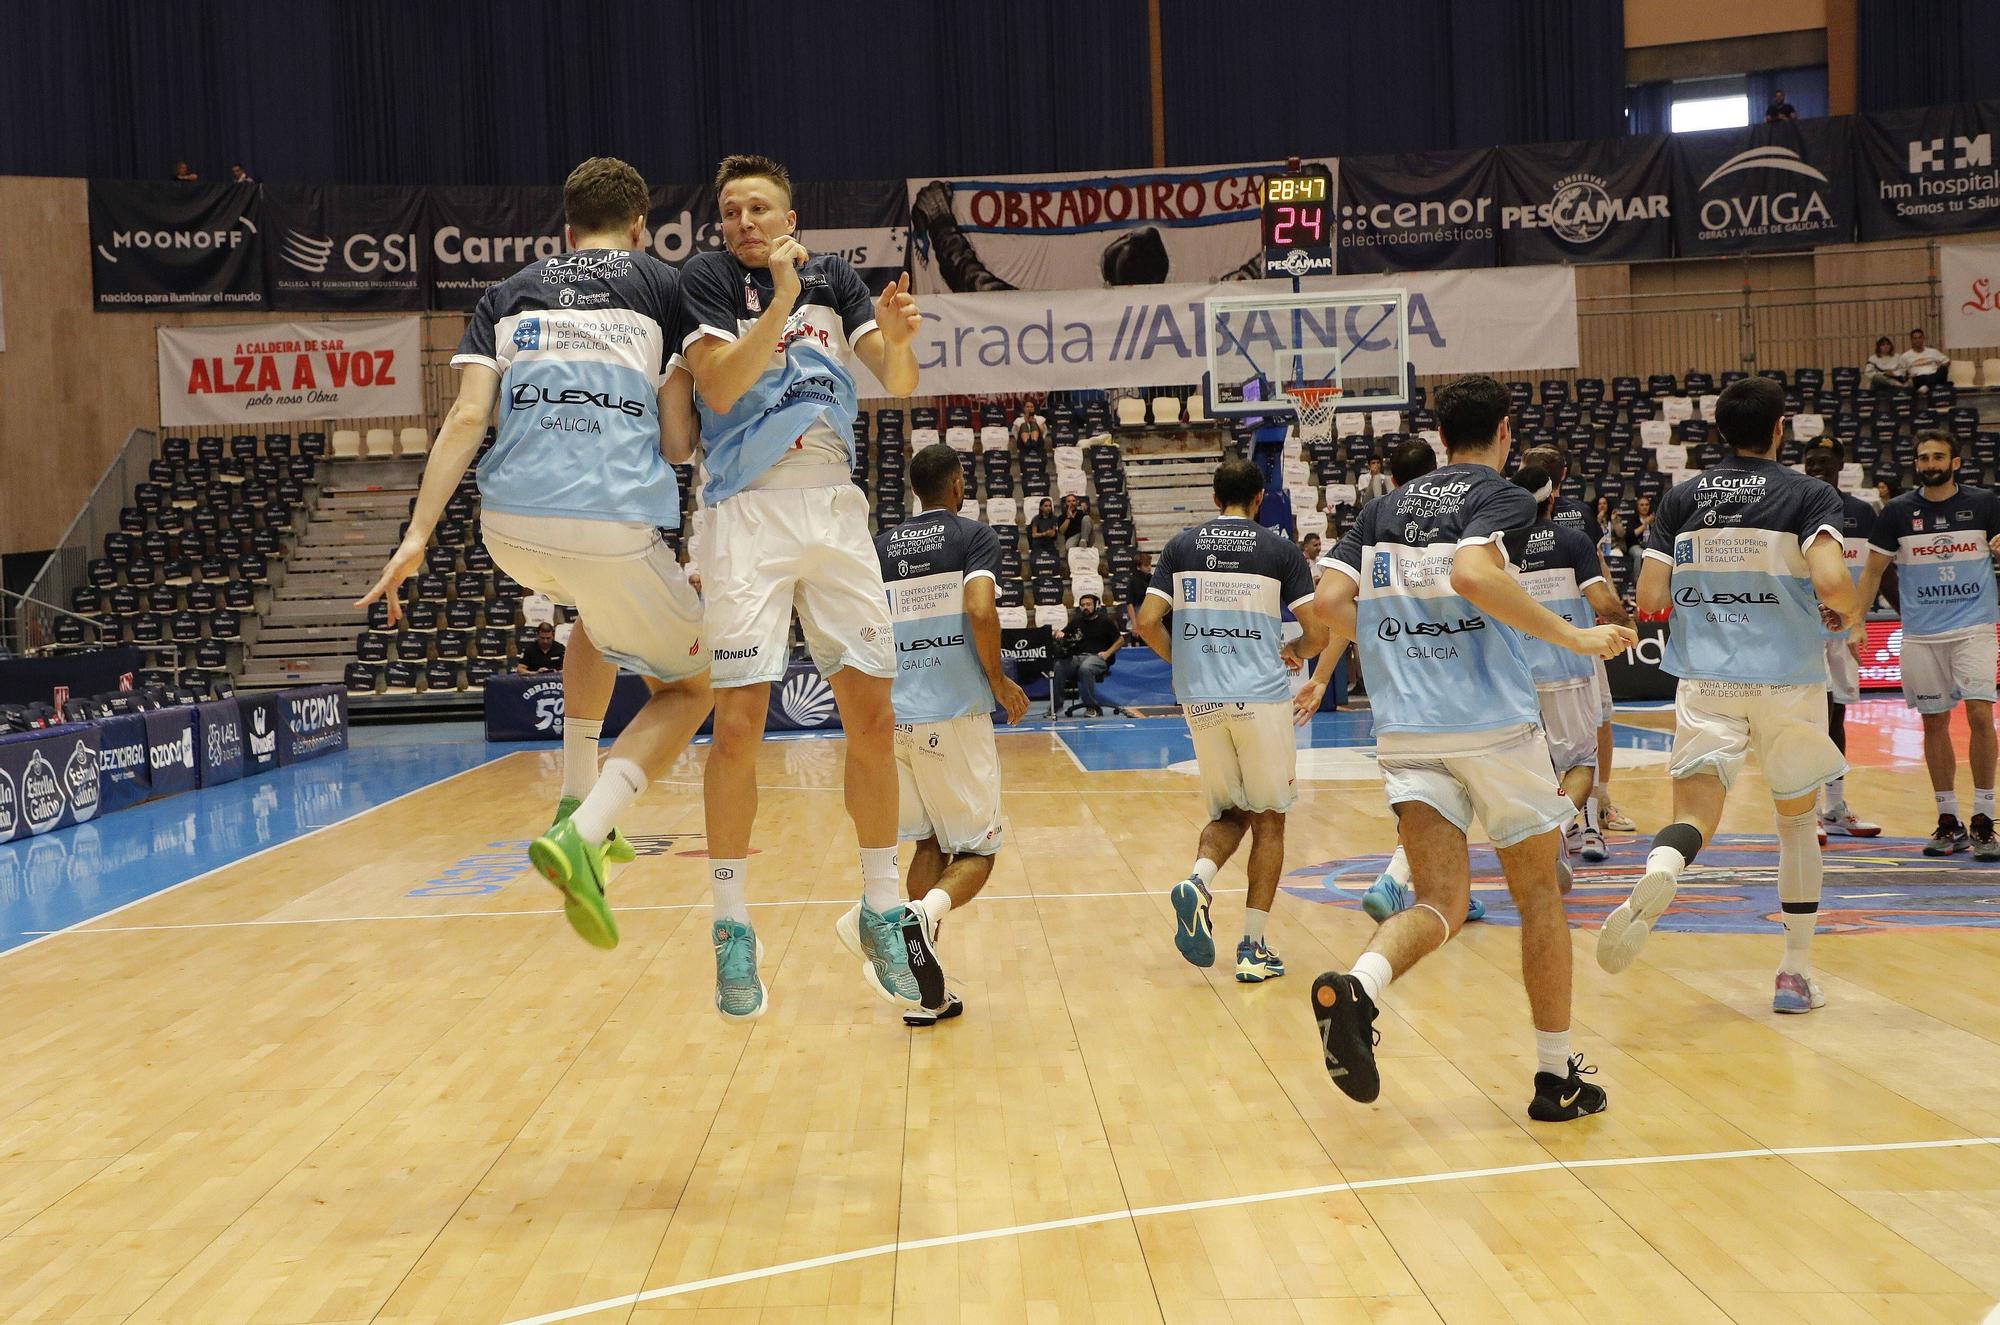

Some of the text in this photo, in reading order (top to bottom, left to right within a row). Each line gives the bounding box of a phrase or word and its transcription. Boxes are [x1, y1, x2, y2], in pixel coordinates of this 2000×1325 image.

[1552, 172, 1608, 191] CONSERVAS
[1880, 170, 2000, 200] hm hospital
[1269, 179, 1324, 200] 28:47
[971, 179, 1206, 230] OBRADOIRO
[1700, 190, 1832, 231] OVIGA
[1896, 202, 1944, 216] Somos
[1949, 200, 1964, 212] tu
[1370, 197, 1492, 229] cenor
[1502, 195, 1671, 230] PESCAMAR
[1275, 207, 1322, 244] 24
[1699, 230, 1727, 240] OBRAS
[1730, 229, 1737, 237] Y
[1739, 226, 1768, 236] VIALES
[1770, 224, 1782, 234] DE
[1785, 220, 1819, 232] GALICIA
[113, 230, 242, 248] MOONOFF
[1342, 227, 1493, 247] electrodomésticos
[343, 233, 418, 273] GSI
[540, 268, 573, 276] UNHA
[1268, 258, 1332, 271] PESCAMAR
[278, 280, 418, 288] GALLEGA DE SUMINISTROS INDUSTRIALES
[542, 269, 628, 285] POR DESCUBRIR
[101, 291, 262, 304] nacidos para iluminar el mundo
[558, 330, 570, 340] DE
[600, 322, 647, 340] SUPERIOR
[556, 340, 569, 350] DE
[918, 309, 1094, 369] Grada
[236, 339, 344, 355] A CALDEIRA DE SAR
[188, 350, 396, 394] ALZA A VOZ
[246, 392, 273, 410] polo
[307, 390, 339, 404] Obra
[542, 388, 645, 418] LEXUS
[540, 416, 602, 434] GALICIA
[1698, 476, 1766, 488] A Coruña
[1694, 488, 1766, 500] UNHA PRVINCIA
[1715, 496, 1761, 507] DSCUBRIR
[1416, 504, 1460, 518] DESCBRR
[890, 525, 944, 541] A Coruña
[1199, 528, 1256, 538] A Coruña
[1530, 530, 1554, 540] ruña
[886, 536, 946, 552] UNHA PROVINCIA
[888, 543, 942, 558] POR DESCUBRIR
[1212, 544, 1253, 552] DESCUBRIR
[1526, 546, 1554, 554] ESCUBRIR
[1528, 540, 1556, 550] ROVINCIA
[1734, 538, 1768, 548] SUPERIOR
[1912, 543, 1978, 556] PESCAMAR
[1715, 547, 1760, 555] HOSTELERÍA
[1426, 556, 1454, 567] SUPER
[901, 583, 958, 597] CENTRO SUPERIOR
[1214, 588, 1252, 596] HOSTELERÍA
[1232, 582, 1261, 590] SUPERIOR
[1918, 582, 1980, 598] SANTIAGO
[912, 592, 949, 604] HOSTELERÍA
[1701, 592, 1780, 604] LEXUS
[912, 602, 936, 612] GALICIA
[1706, 612, 1750, 623] GALICIA
[1201, 626, 1262, 640] LEXUS
[1405, 616, 1486, 636] LEXUS
[901, 634, 964, 652] LEXUS
[1202, 644, 1236, 655] GALICIA
[714, 646, 758, 661] MONBUS
[1406, 646, 1458, 660] GALICIA
[902, 656, 942, 671] GALICIA
[522, 682, 562, 700] OBRADO
[1700, 688, 1716, 697] POR
[1718, 690, 1762, 698] DESCUBRIR
[302, 694, 340, 732] cenor
